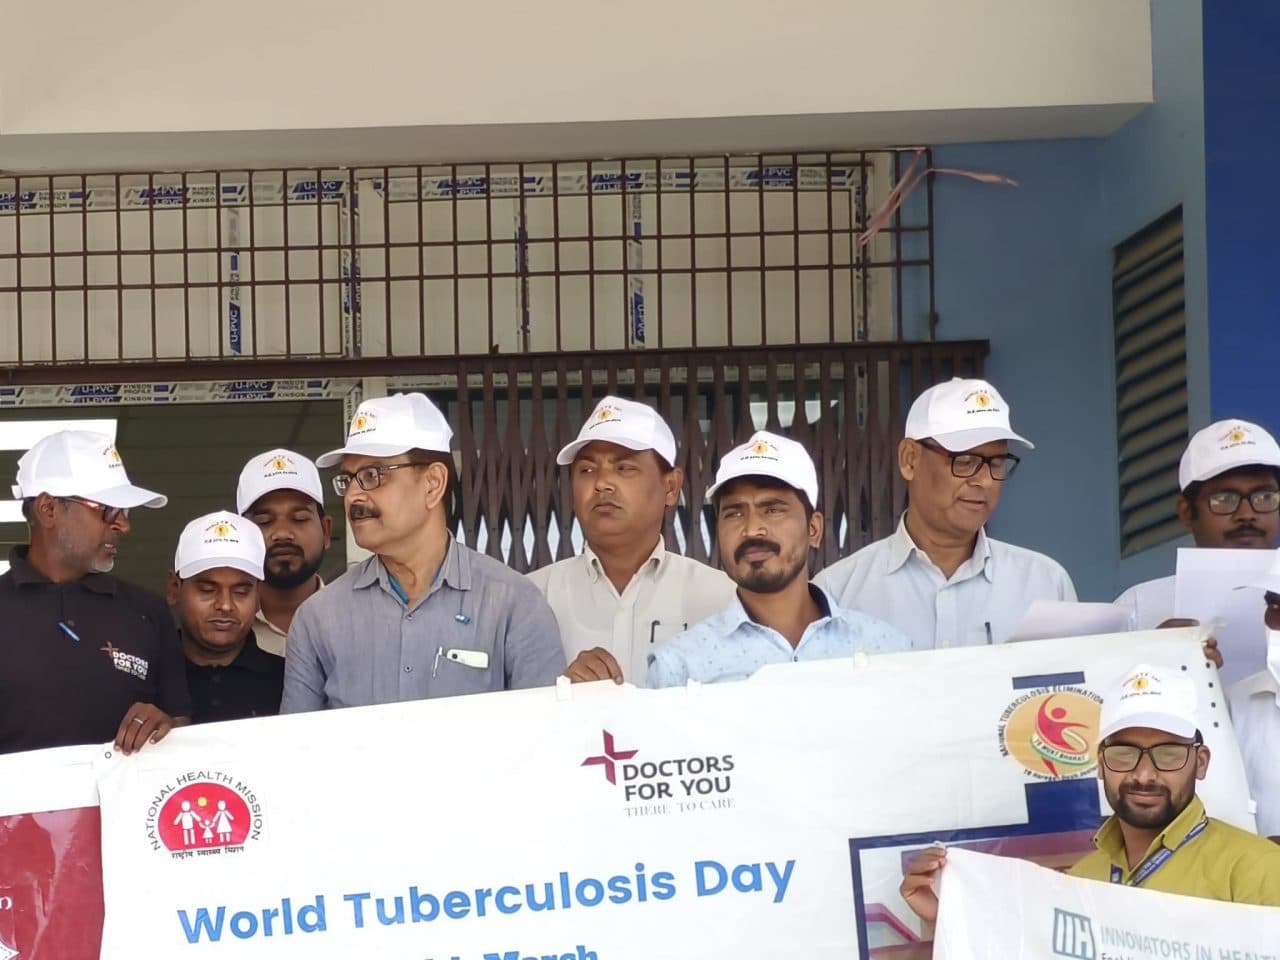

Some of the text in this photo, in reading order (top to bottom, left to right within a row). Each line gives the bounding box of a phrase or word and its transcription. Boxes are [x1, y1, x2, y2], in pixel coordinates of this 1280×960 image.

[132, 663, 148, 676] YOU
[623, 755, 735, 781] DOCTORS
[625, 776, 731, 802] FOR YOU
[146, 770, 263, 851] NATIONAL HEALTH MISSION
[624, 798, 736, 818] THERE TO CARE
[177, 856, 798, 944] World Tuberculosis Day
[1100, 925, 1191, 960] INNOVATORS
